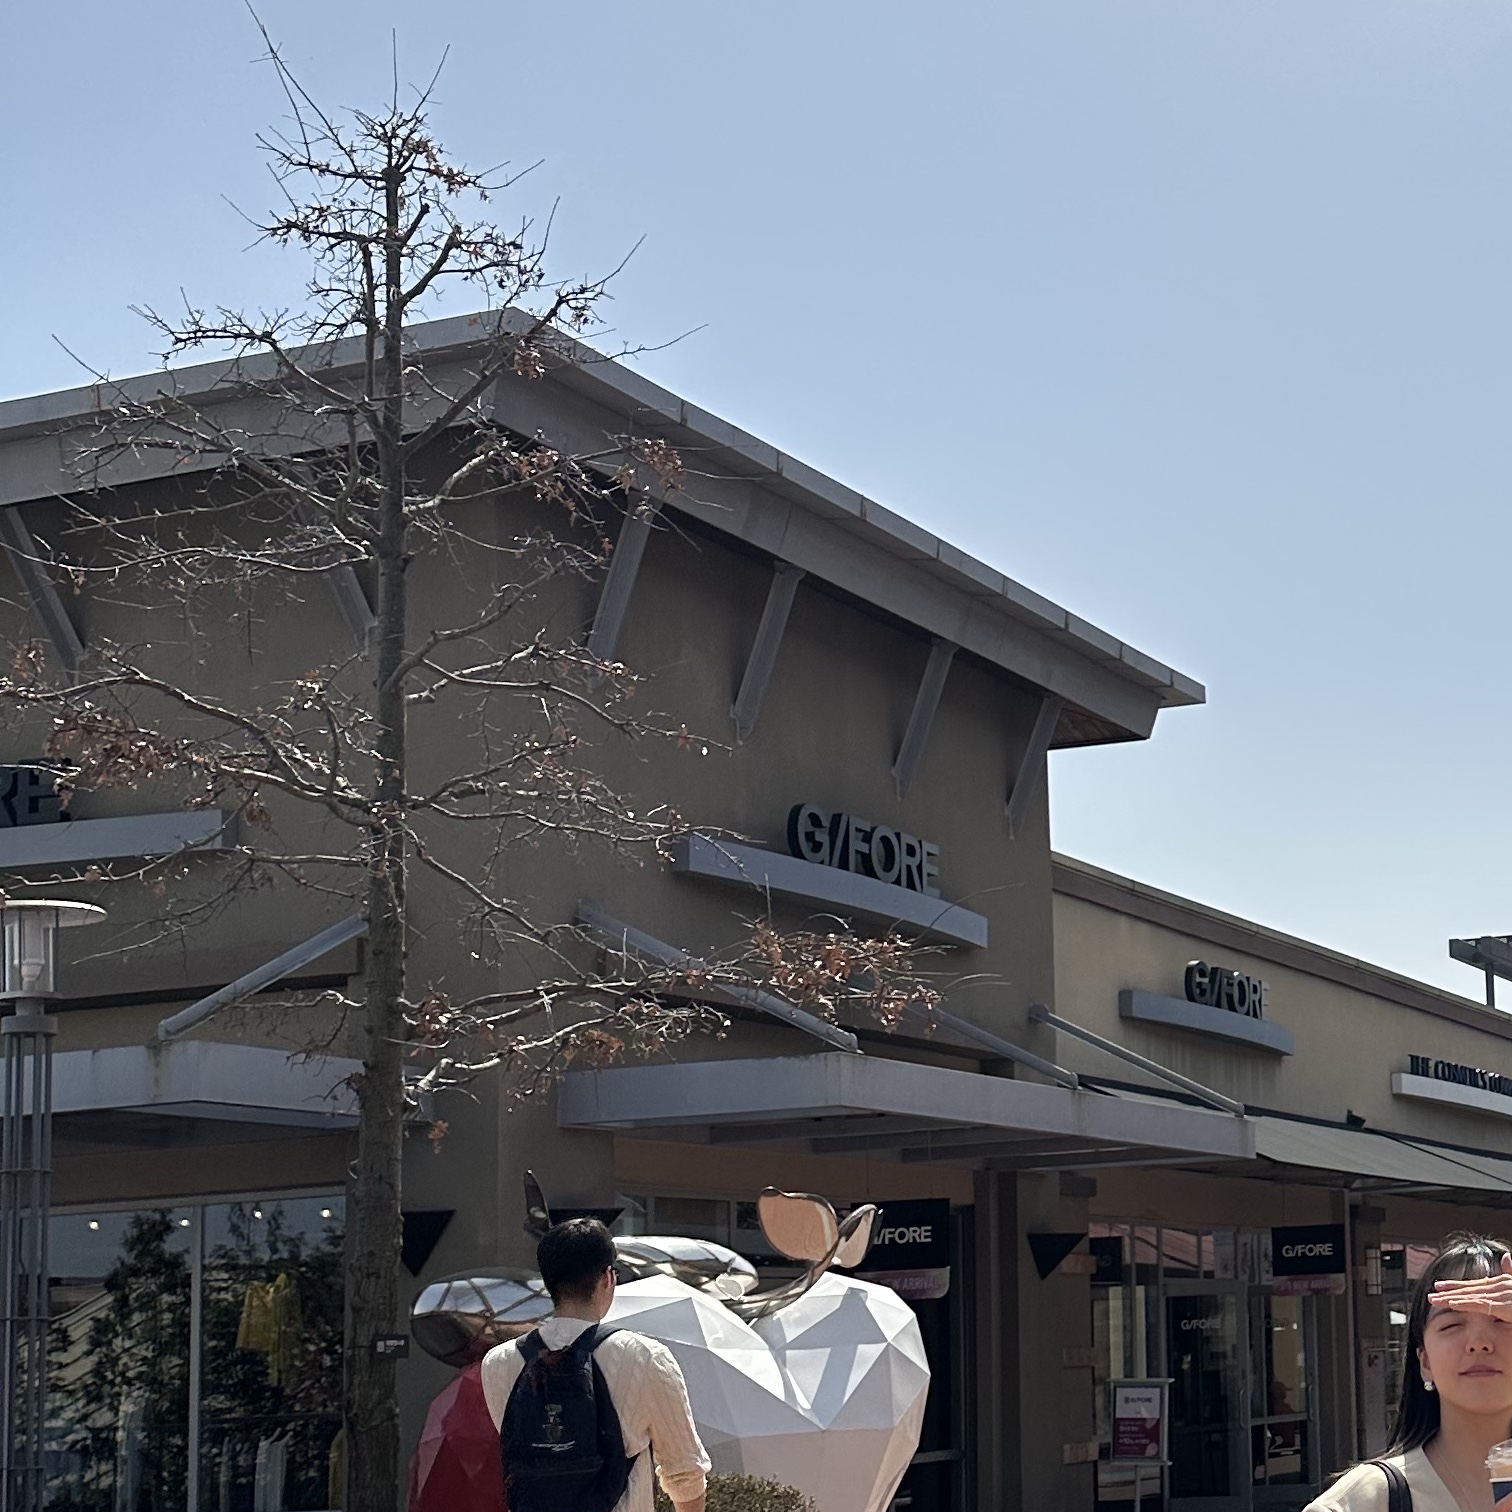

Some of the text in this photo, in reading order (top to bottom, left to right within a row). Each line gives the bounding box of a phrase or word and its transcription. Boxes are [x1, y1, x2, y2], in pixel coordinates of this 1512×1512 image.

[788, 803, 940, 899] G/FORE
[1185, 960, 1270, 1023] G/FORE
[1282, 1243, 1334, 1258] G/FORE
